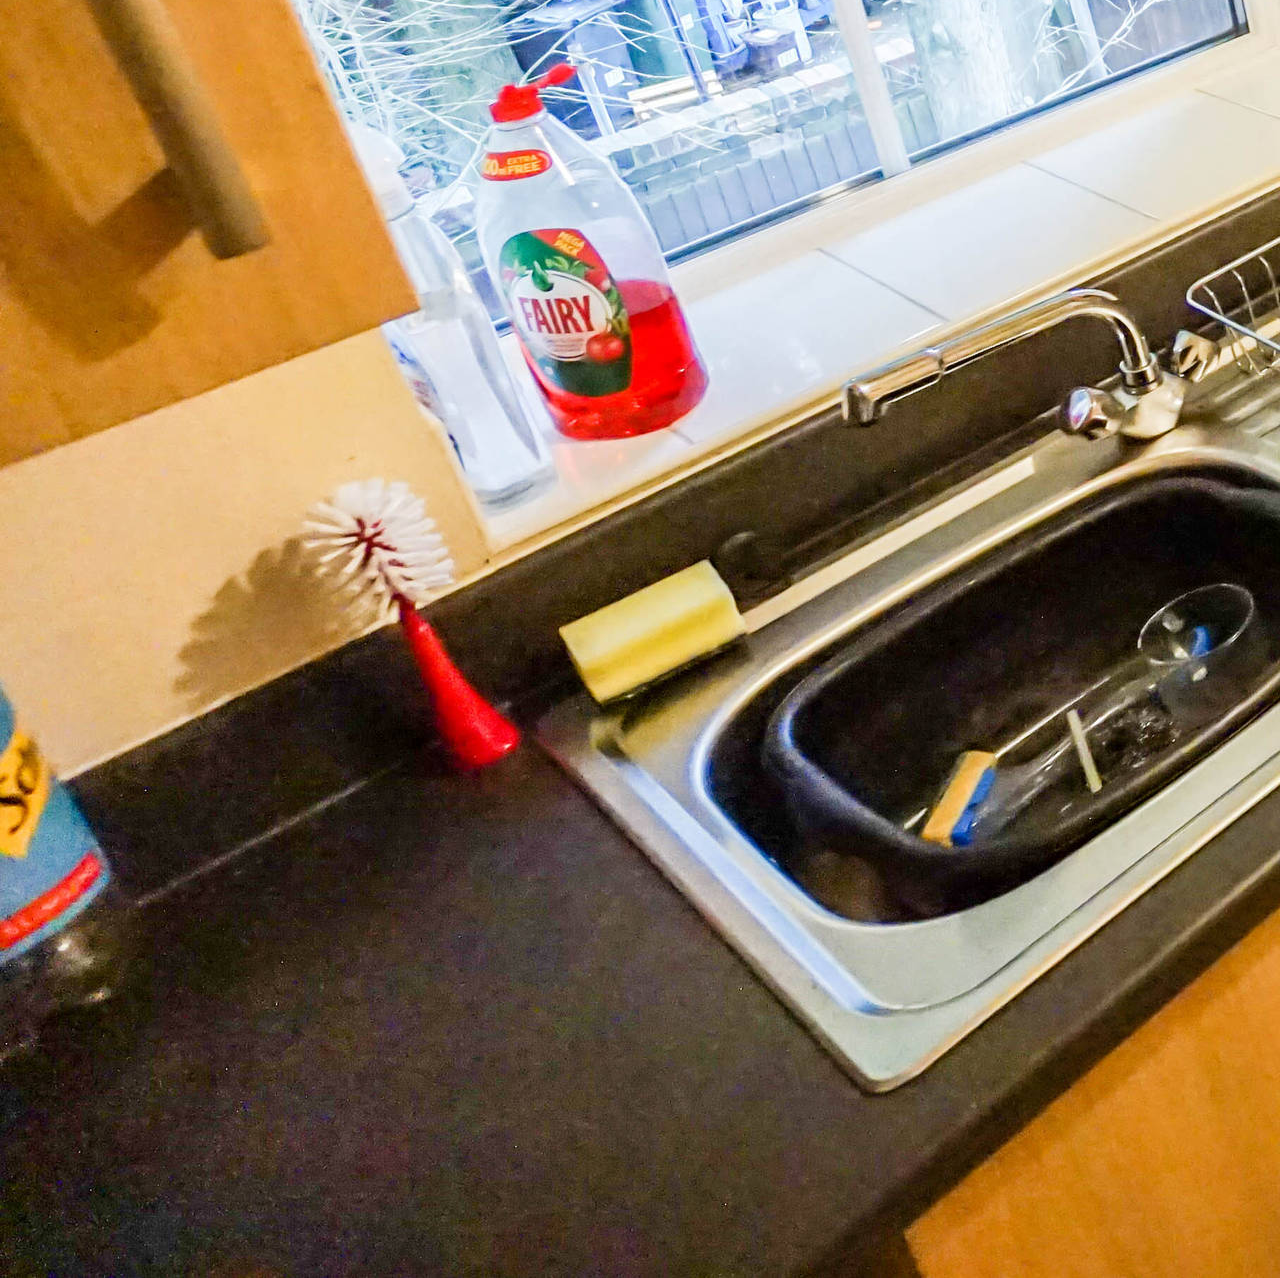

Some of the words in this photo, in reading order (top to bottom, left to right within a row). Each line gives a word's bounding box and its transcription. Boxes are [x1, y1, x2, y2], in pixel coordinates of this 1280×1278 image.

[507, 154, 537, 165] EXTRA
[507, 161, 541, 174] FREE
[553, 240, 579, 257] PACK
[558, 231, 585, 250] MEGA
[518, 295, 595, 334] FAIRY
